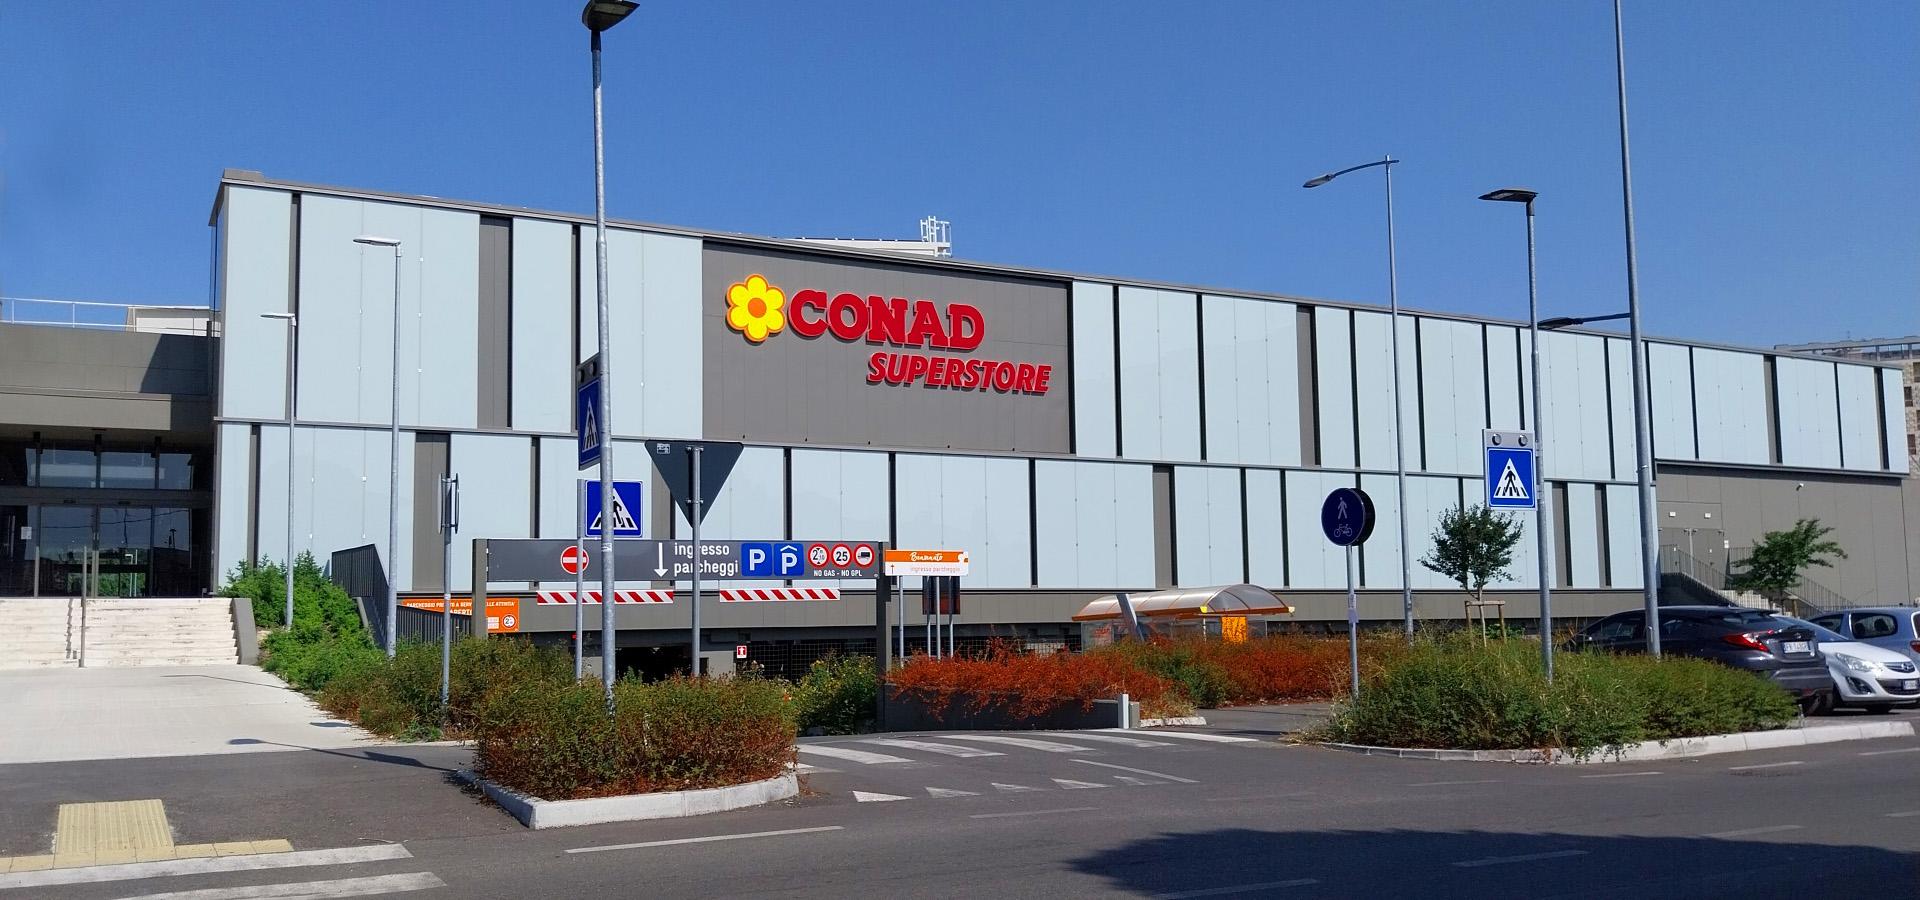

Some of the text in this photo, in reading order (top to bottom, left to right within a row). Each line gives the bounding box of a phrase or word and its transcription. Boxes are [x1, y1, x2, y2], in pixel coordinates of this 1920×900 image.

[788, 289, 986, 351] CONAD
[867, 352, 1052, 394] SUPERSTORE
[674, 542, 730, 559] ingesso
[749, 549, 766, 571] P
[836, 551, 848, 561] 25
[781, 553, 798, 574] P
